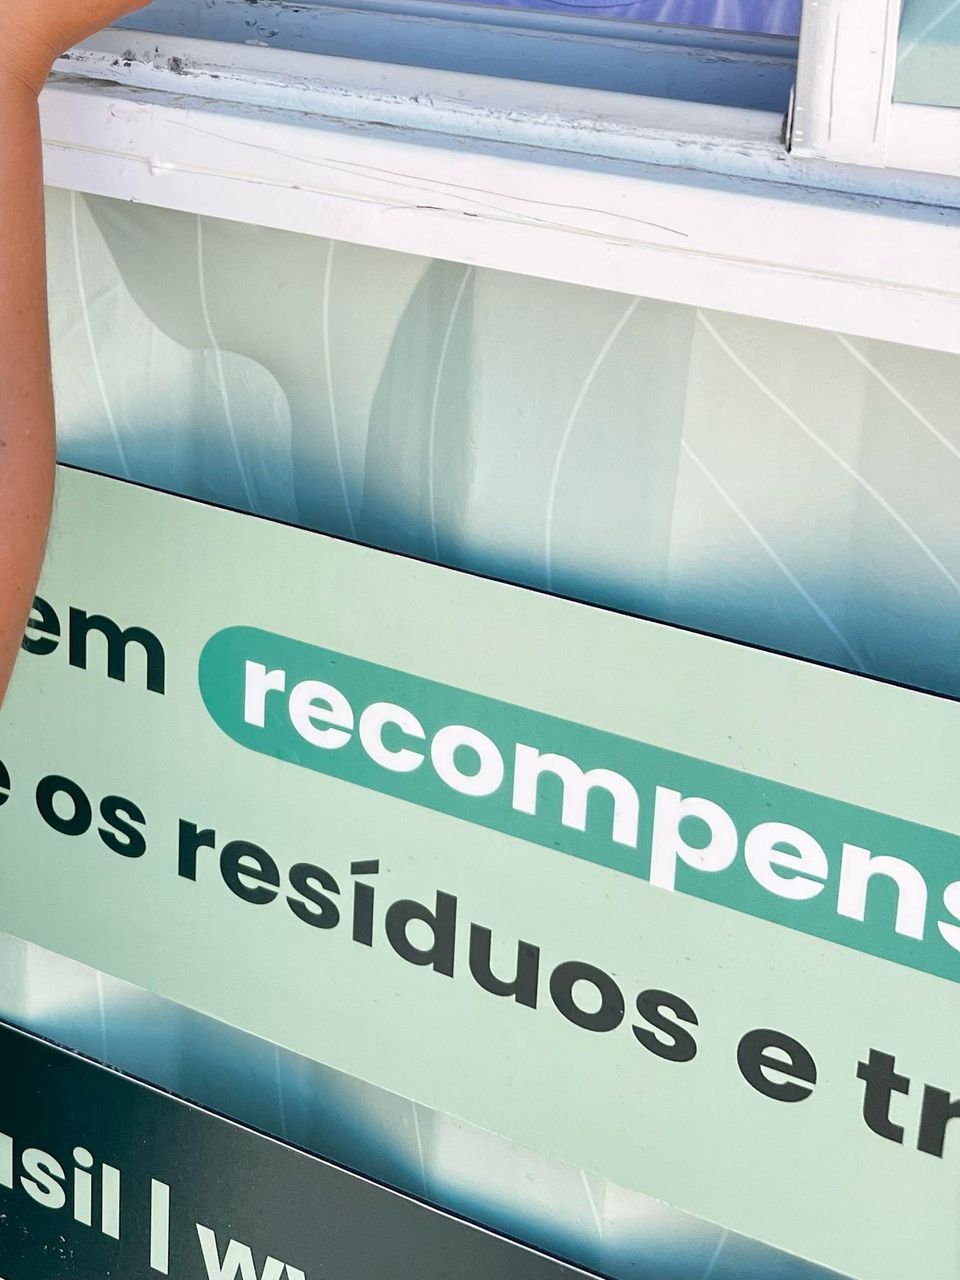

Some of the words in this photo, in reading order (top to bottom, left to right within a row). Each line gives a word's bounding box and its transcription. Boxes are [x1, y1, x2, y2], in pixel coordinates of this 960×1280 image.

[35, 774, 147, 858] os
[178, 818, 700, 1063] resíduos
[736, 1028, 818, 1104] e
